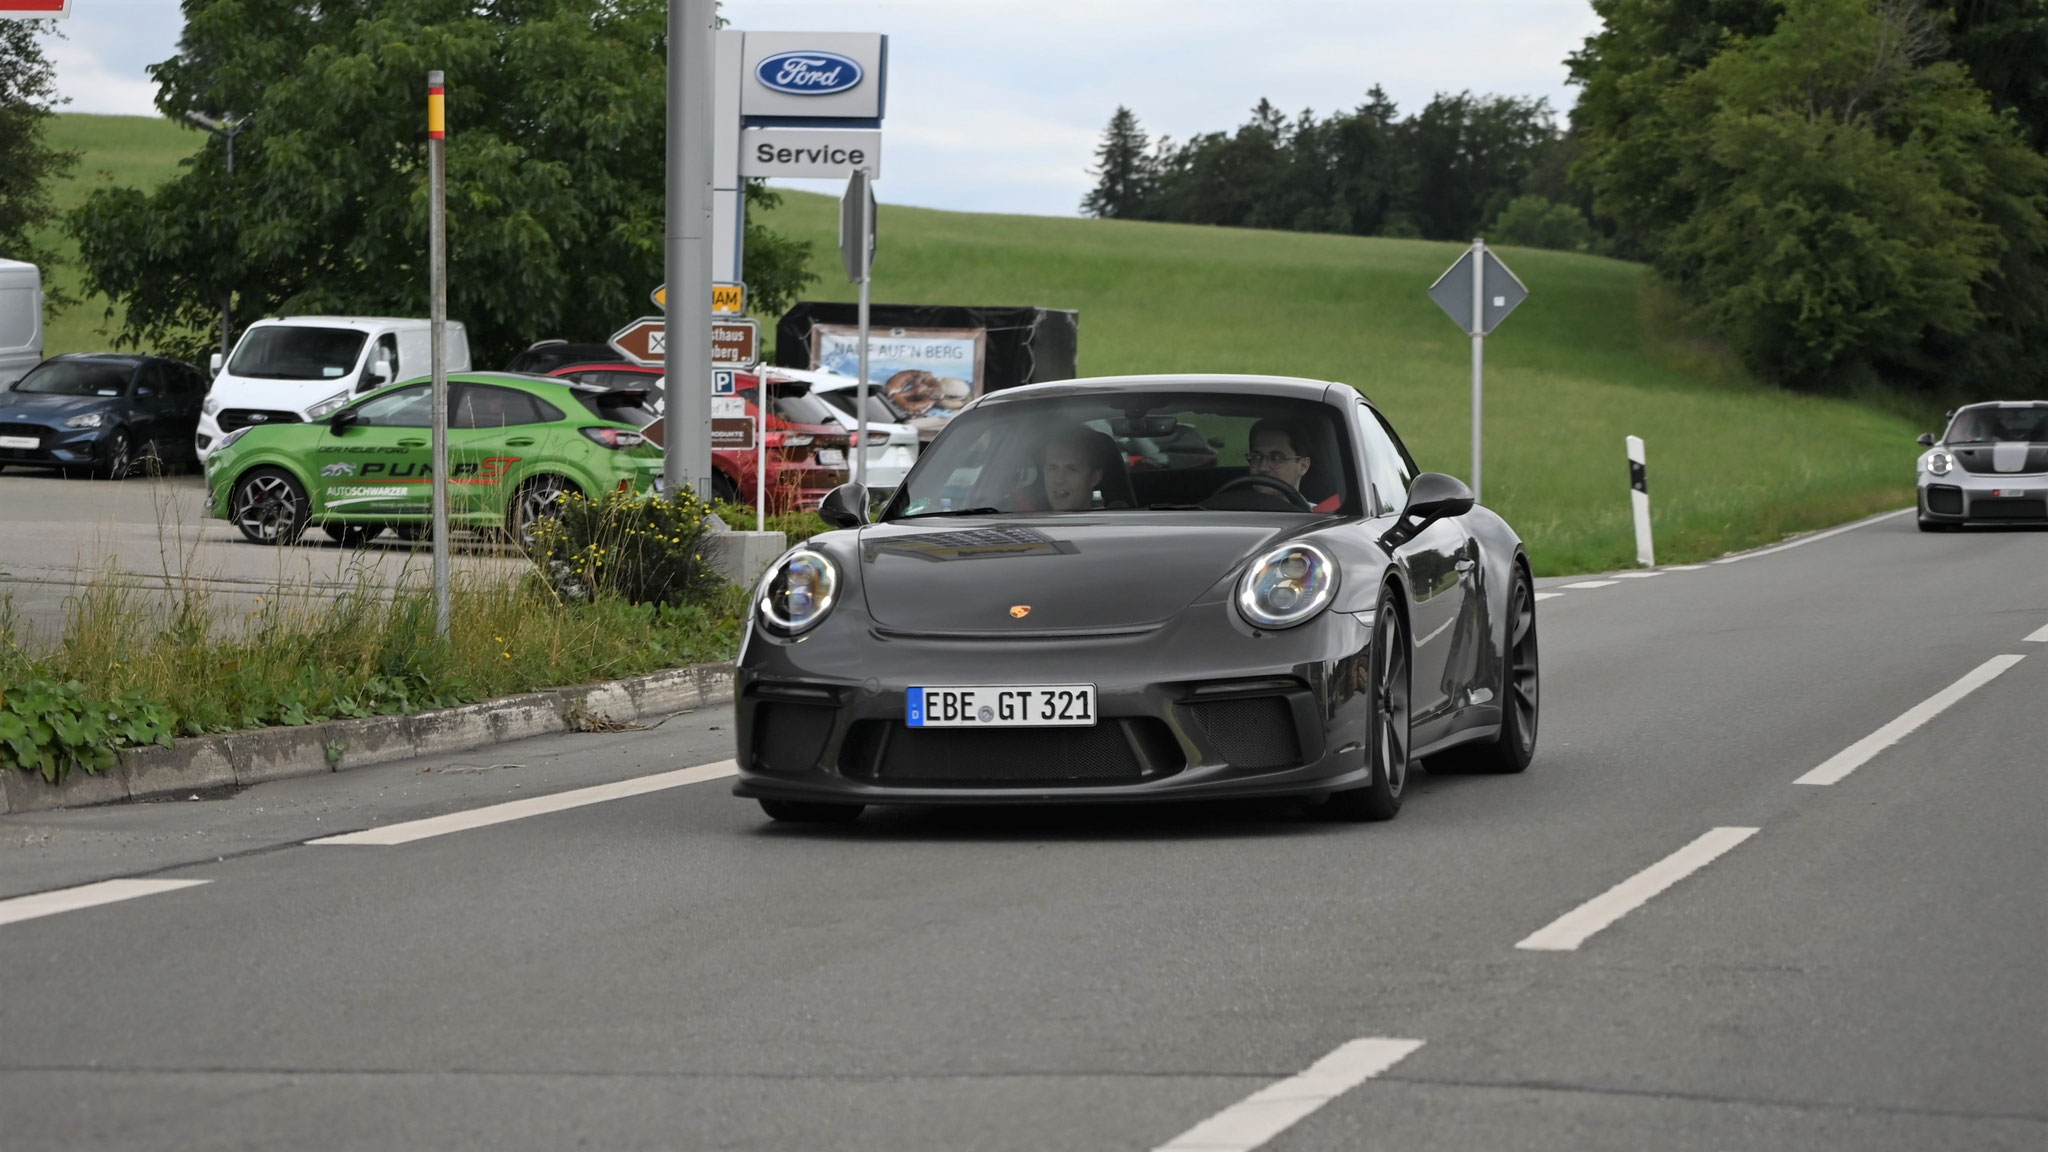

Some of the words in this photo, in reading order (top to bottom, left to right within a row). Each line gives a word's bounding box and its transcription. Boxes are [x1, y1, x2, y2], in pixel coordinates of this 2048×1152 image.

[776, 57, 842, 86] Ford
[756, 143, 865, 165] Service
[712, 328, 744, 341] sthaus
[711, 344, 739, 361] berg
[925, 346, 963, 360] BERG
[716, 373, 730, 391] P
[926, 692, 976, 721] EBE
[998, 692, 1032, 720] GT
[1041, 691, 1091, 720] 321
